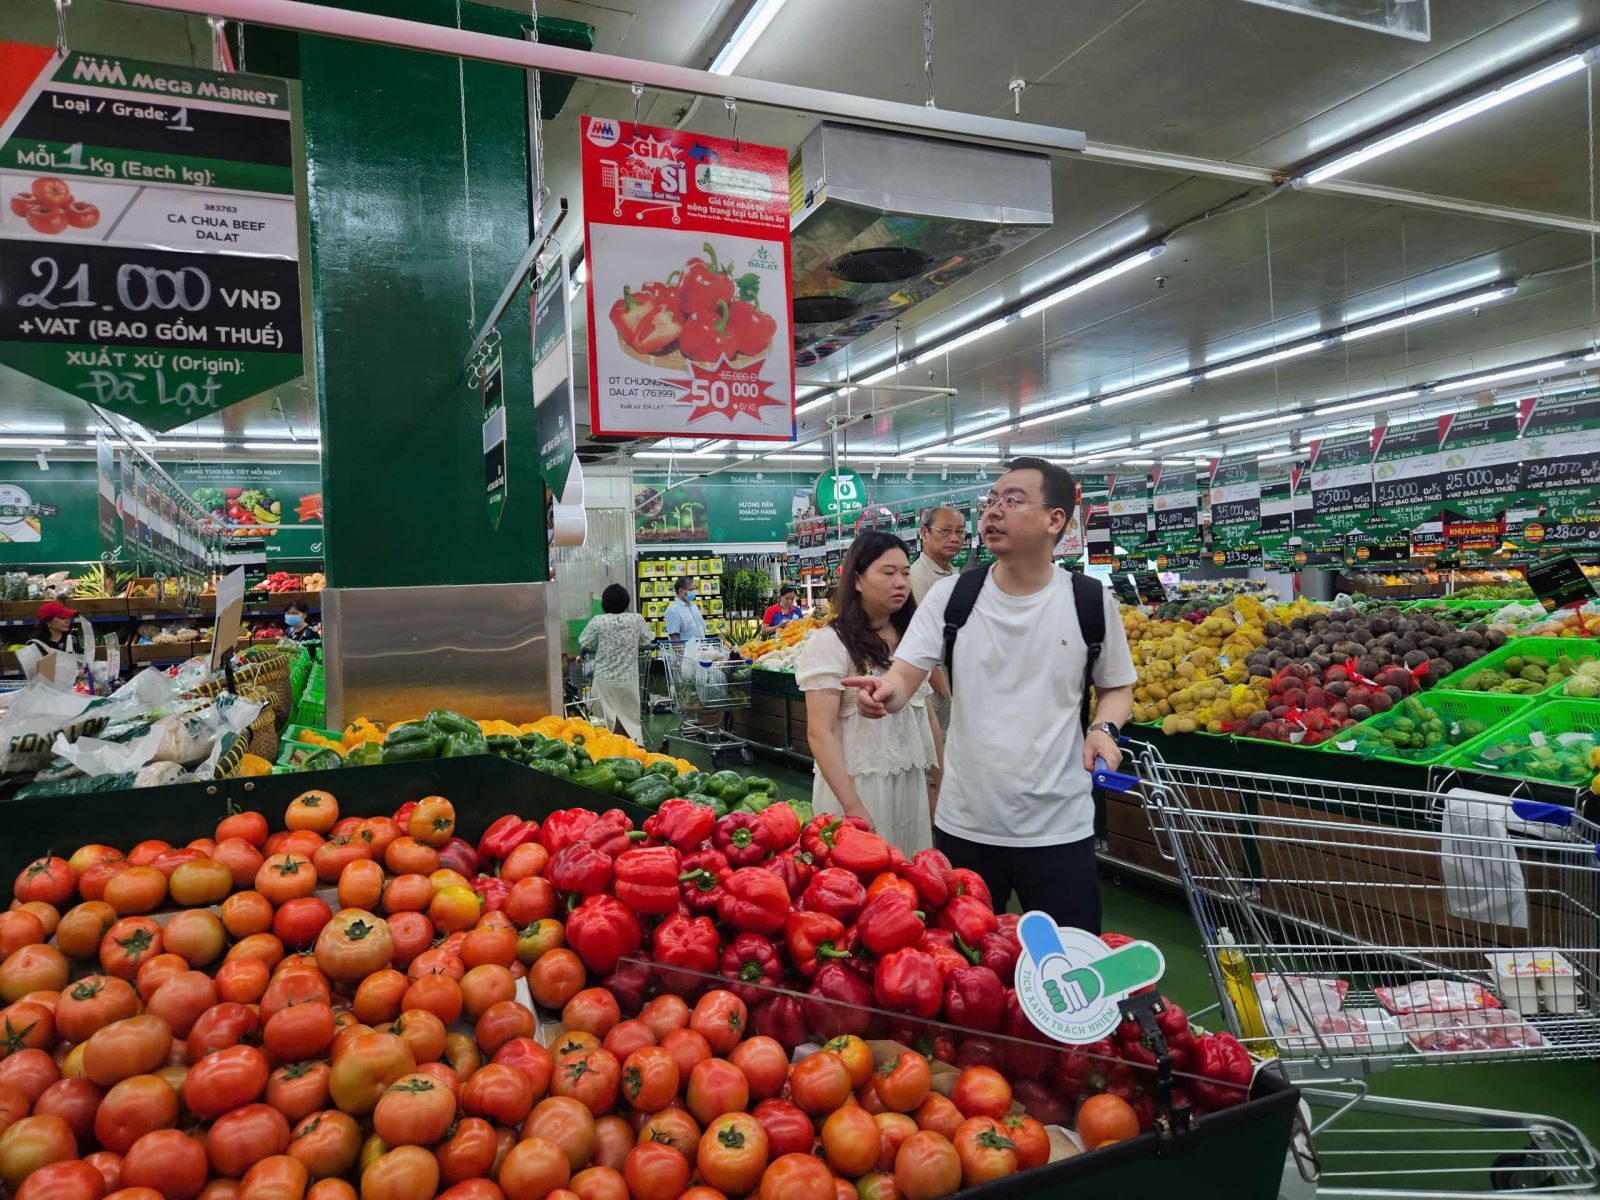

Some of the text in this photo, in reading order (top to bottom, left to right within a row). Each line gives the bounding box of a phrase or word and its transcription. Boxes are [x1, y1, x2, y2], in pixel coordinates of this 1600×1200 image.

[132, 73, 278, 105] Mega Market
[52, 95, 194, 132] Loại / Grade: 1
[633, 140, 677, 161] GIÁ
[53, 141, 89, 170] 1
[90, 157, 115, 178] Kg
[121, 162, 176, 180] (Each
[182, 165, 215, 186] kg):
[660, 161, 688, 194] SỈ
[204, 204, 238, 214] 383763
[708, 196, 722, 206] Giá
[710, 206, 730, 216] trang
[168, 214, 266, 232] CA CHUA BEEF
[196, 230, 240, 243] DALAT
[748, 262, 778, 270] DALAT
[17, 256, 281, 312] 21.000 VNĐ
[18, 316, 284, 348] +VAT (BAO GỒM THUẾ)
[66, 345, 245, 374] XUẤT XỨ (Origin):
[608, 376, 621, 384] OT
[610, 388, 676, 398] DALAT (76399)
[692, 380, 758, 408] 50 000
[1446, 470, 1493, 490] 25.000
[1545, 480, 1562, 488] (BAO
[1379, 482, 1418, 502] 25.000
[1024, 970, 1116, 1034] TICK XANH TRÁCH NHIỆM
